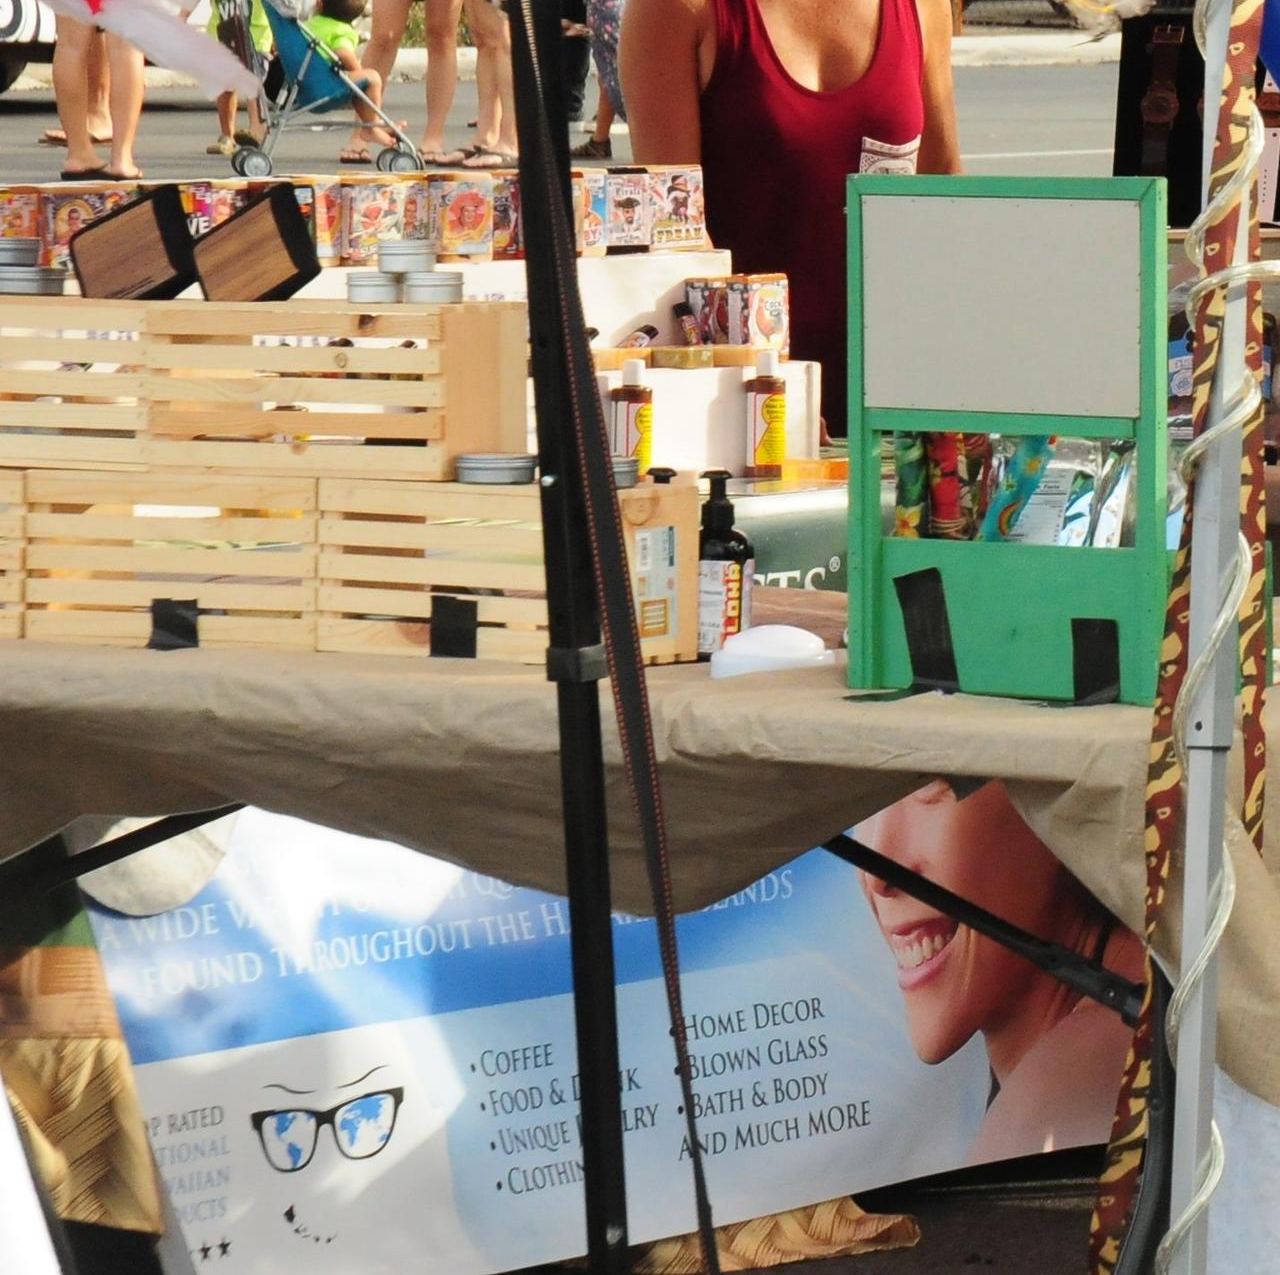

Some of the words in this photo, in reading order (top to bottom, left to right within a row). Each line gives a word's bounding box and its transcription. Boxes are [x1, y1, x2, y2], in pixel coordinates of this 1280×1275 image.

[723, 562, 742, 635] LOHA
[128, 902, 220, 946] WIDE
[143, 950, 263, 997] FOUND
[270, 918, 472, 978] THROUGHOUT
[477, 909, 536, 947] THE
[683, 1009, 748, 1042] HOME
[753, 996, 826, 1031] DECOR
[479, 1042, 554, 1077] COFFEE
[688, 1045, 762, 1082] BLOWN
[767, 1033, 829, 1067] GLASS
[488, 1085, 544, 1117] FOOD
[549, 1077, 566, 1106] &
[692, 1087, 745, 1121] BATH
[751, 1080, 770, 1109] &
[773, 1071, 829, 1106] BODY
[167, 1104, 225, 1135] RATED
[498, 1119, 572, 1157] UNIQUE
[678, 1130, 728, 1162] AND
[734, 1116, 801, 1152] MUCH
[807, 1099, 873, 1138] MORE
[507, 1159, 586, 1195] CLOTHIN
